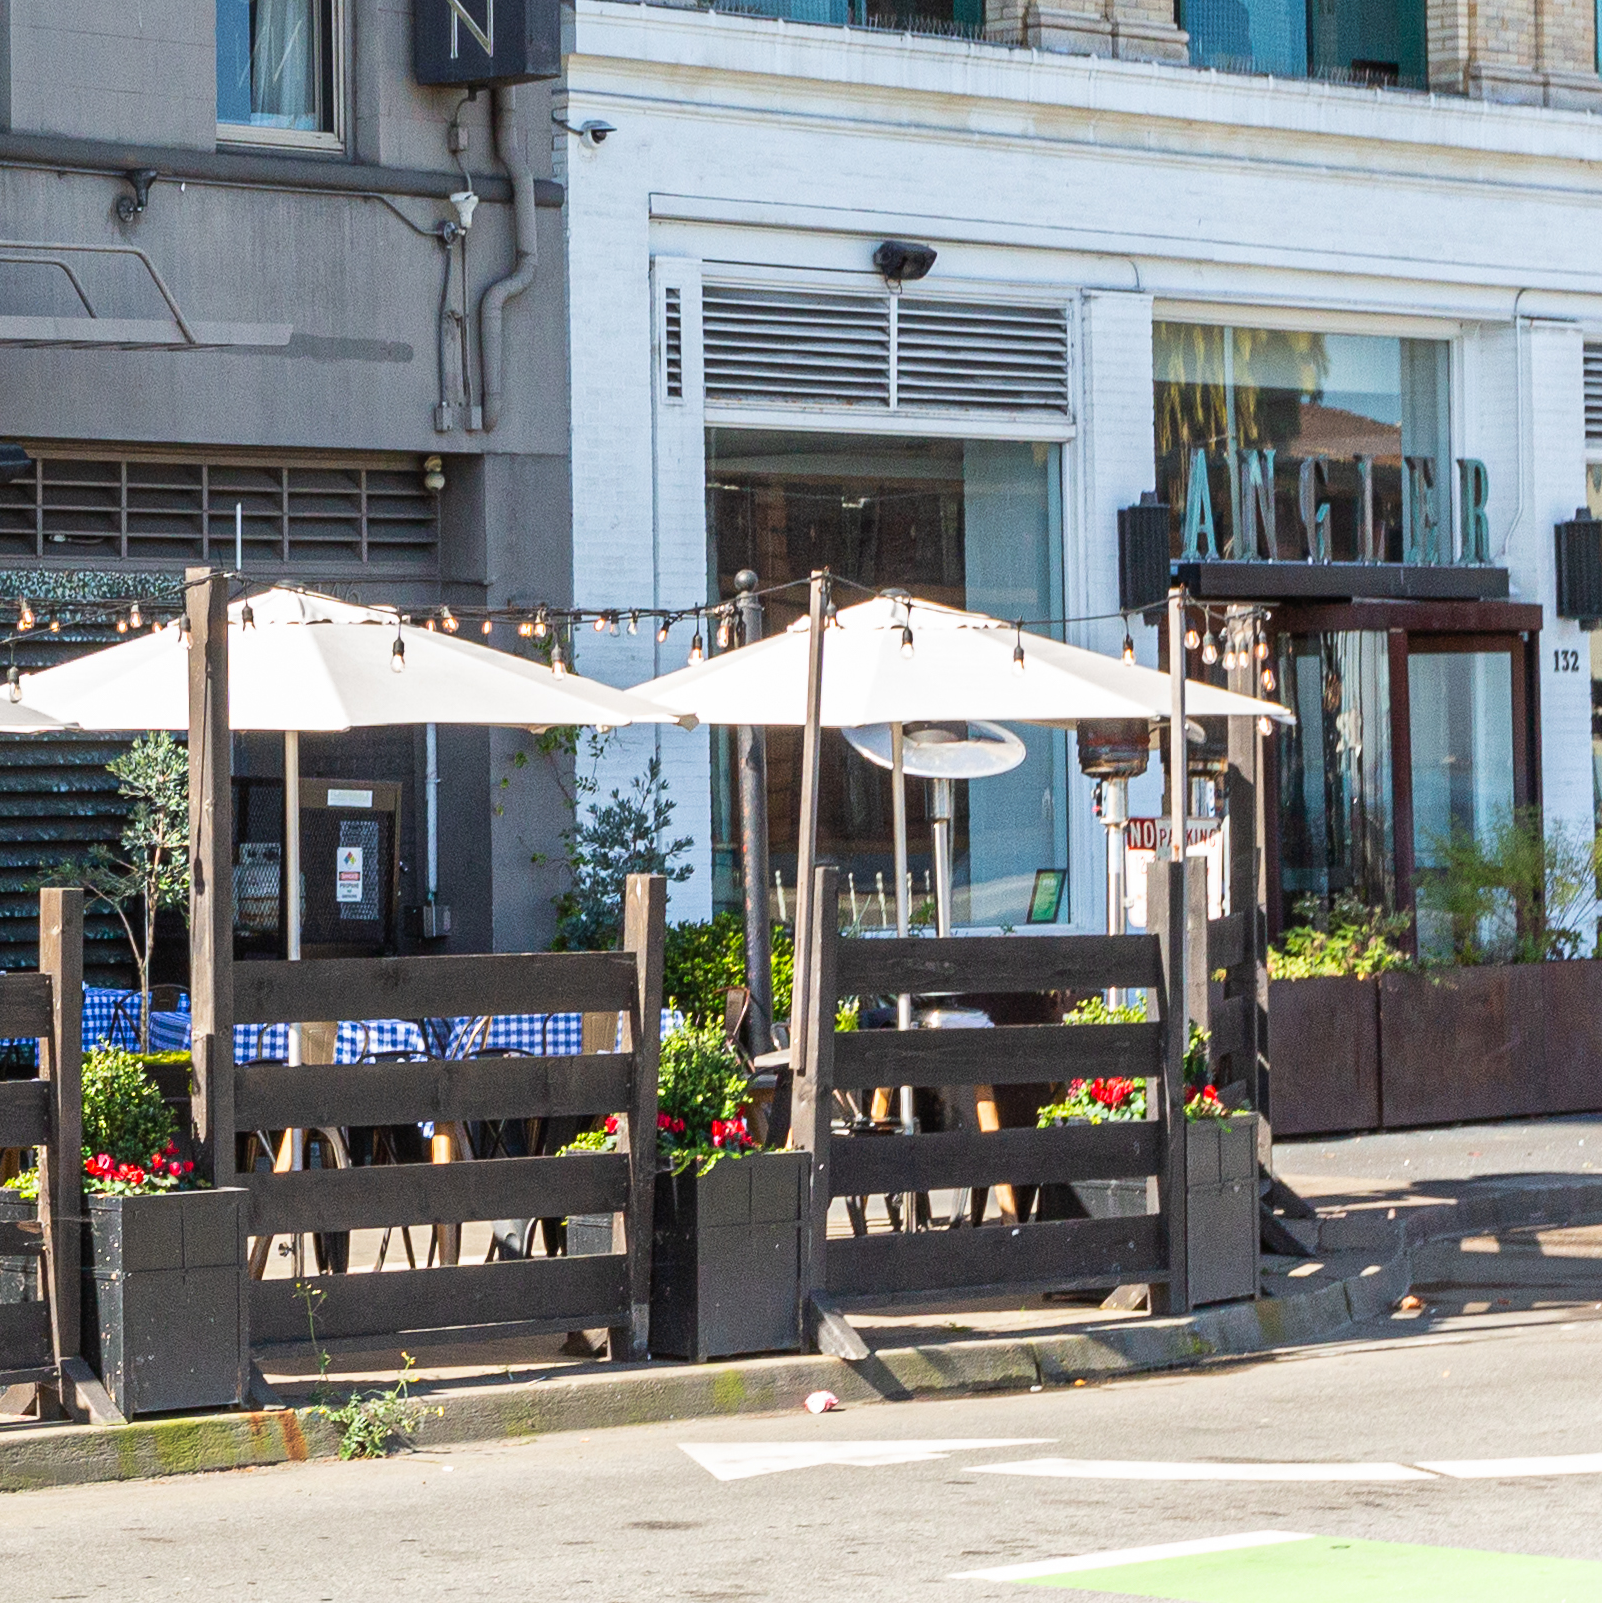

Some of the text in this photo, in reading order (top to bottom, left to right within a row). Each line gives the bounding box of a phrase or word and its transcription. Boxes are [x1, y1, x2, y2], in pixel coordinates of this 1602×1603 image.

[1553, 649, 1580, 673] 132
[1128, 820, 1217, 849] NO PAKING
